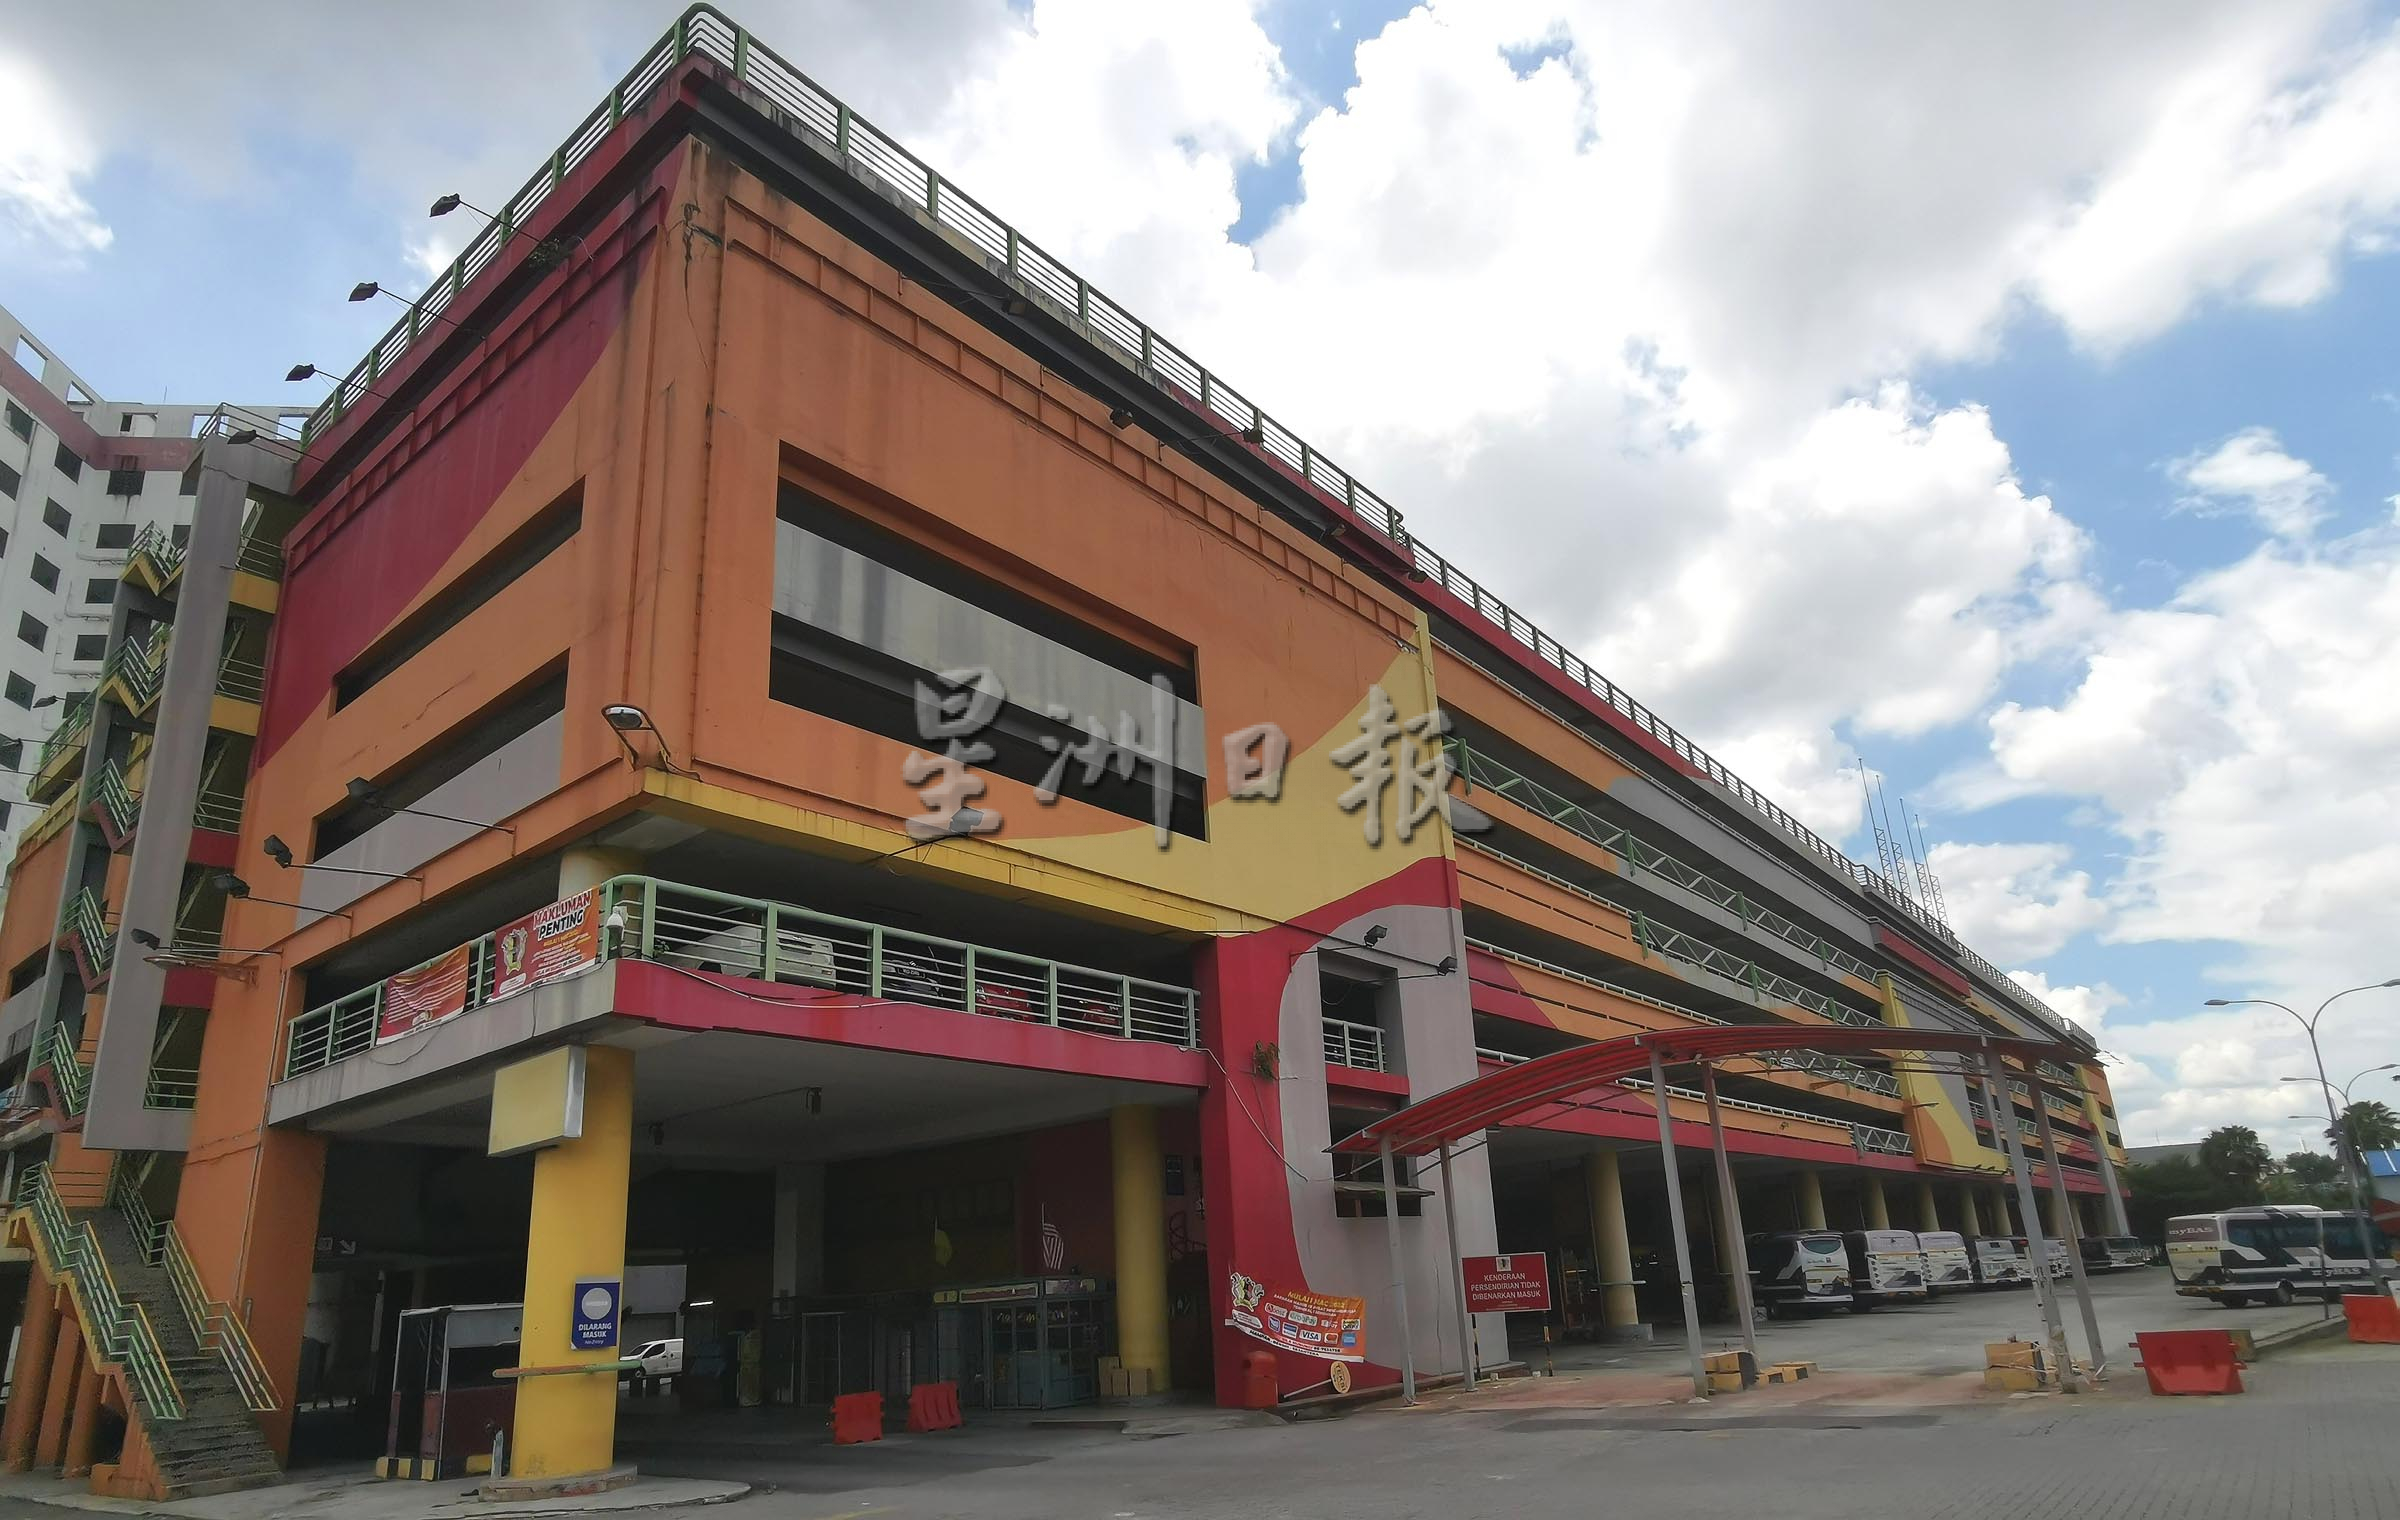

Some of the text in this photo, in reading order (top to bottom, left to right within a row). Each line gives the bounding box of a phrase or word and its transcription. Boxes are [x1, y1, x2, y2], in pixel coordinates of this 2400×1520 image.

[533, 889, 592, 928] MAKLUMAN
[538, 908, 585, 941] PENTING
[1484, 1272, 1526, 1281] KENDERAAN
[1471, 1281, 1541, 1291] PERSENDIRIAN TIDAK
[1472, 1290, 1541, 1301] DIBENARKAN MASUK
[578, 1323, 612, 1331] DILARANG
[1302, 1330, 1319, 1340] VISA
